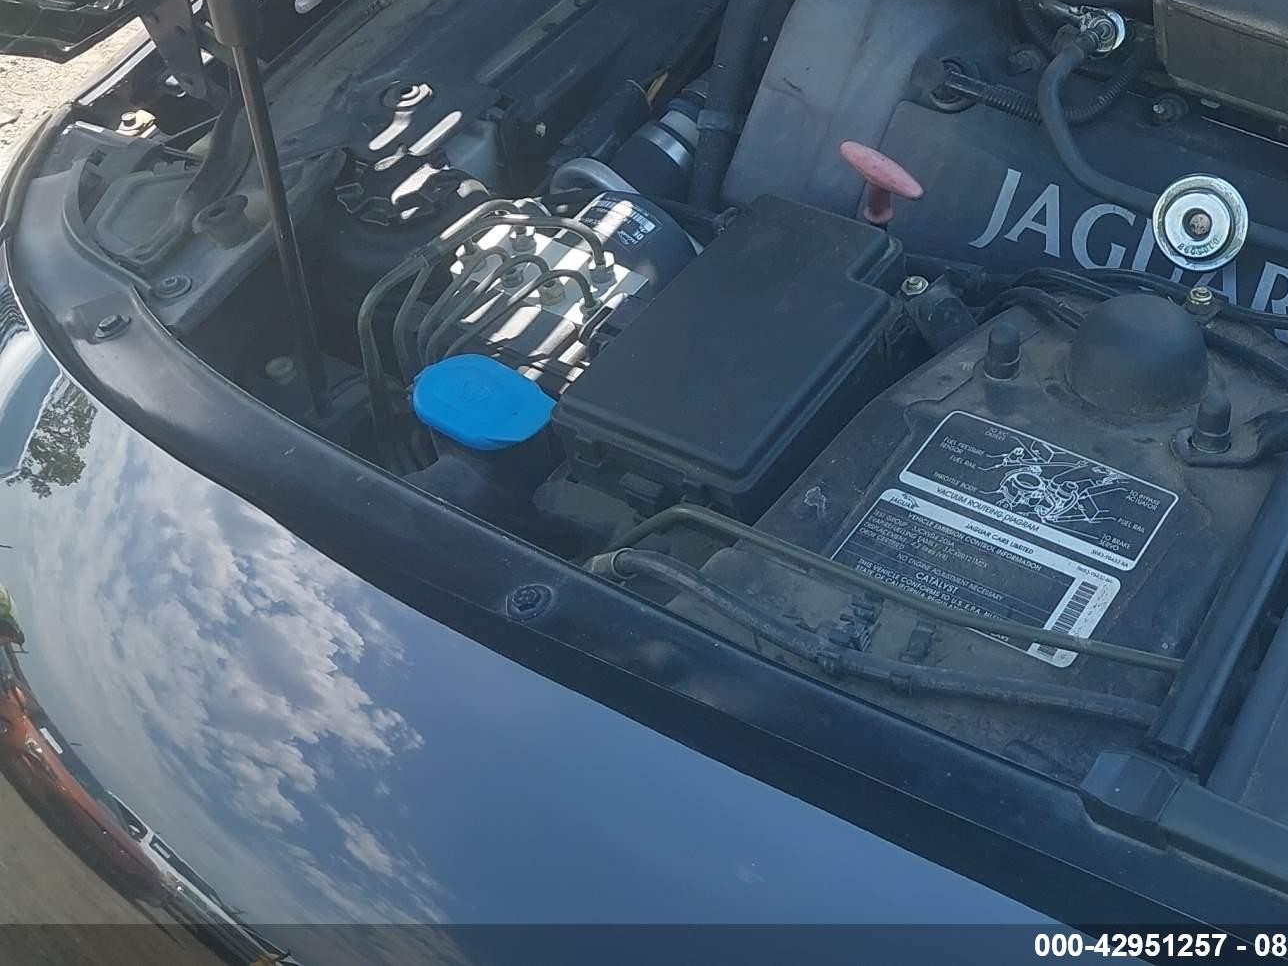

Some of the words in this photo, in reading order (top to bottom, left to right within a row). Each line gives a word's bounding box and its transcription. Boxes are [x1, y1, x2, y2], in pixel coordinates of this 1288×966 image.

[889, 496, 915, 510] JAGUAR
[935, 486, 967, 502] VACUUM
[967, 499, 1003, 517] ROUTEING
[1003, 514, 1040, 532] DIAGRAM
[906, 512, 934, 526] VEHICLE
[933, 523, 965, 539] EMISSION
[964, 535, 996, 552] CONTROL
[995, 548, 1042, 570] INFORMATION
[965, 524, 991, 537] JAGUAR
[991, 534, 1009, 544] CARS
[1009, 541, 1034, 554] LIMITED
[1110, 537, 1131, 549] BRAKE
[854, 565, 874, 576] STATE
[857, 558, 872, 567] THIS
[871, 564, 900, 579] VEHICLE
[899, 576, 940, 596] CONFORMS
[907, 558, 931, 570] ENGINE
[931, 567, 969, 586] ADJUSTMENT
[968, 583, 1003, 600] NECESSARY
[914, 571, 958, 593] CATALYST
